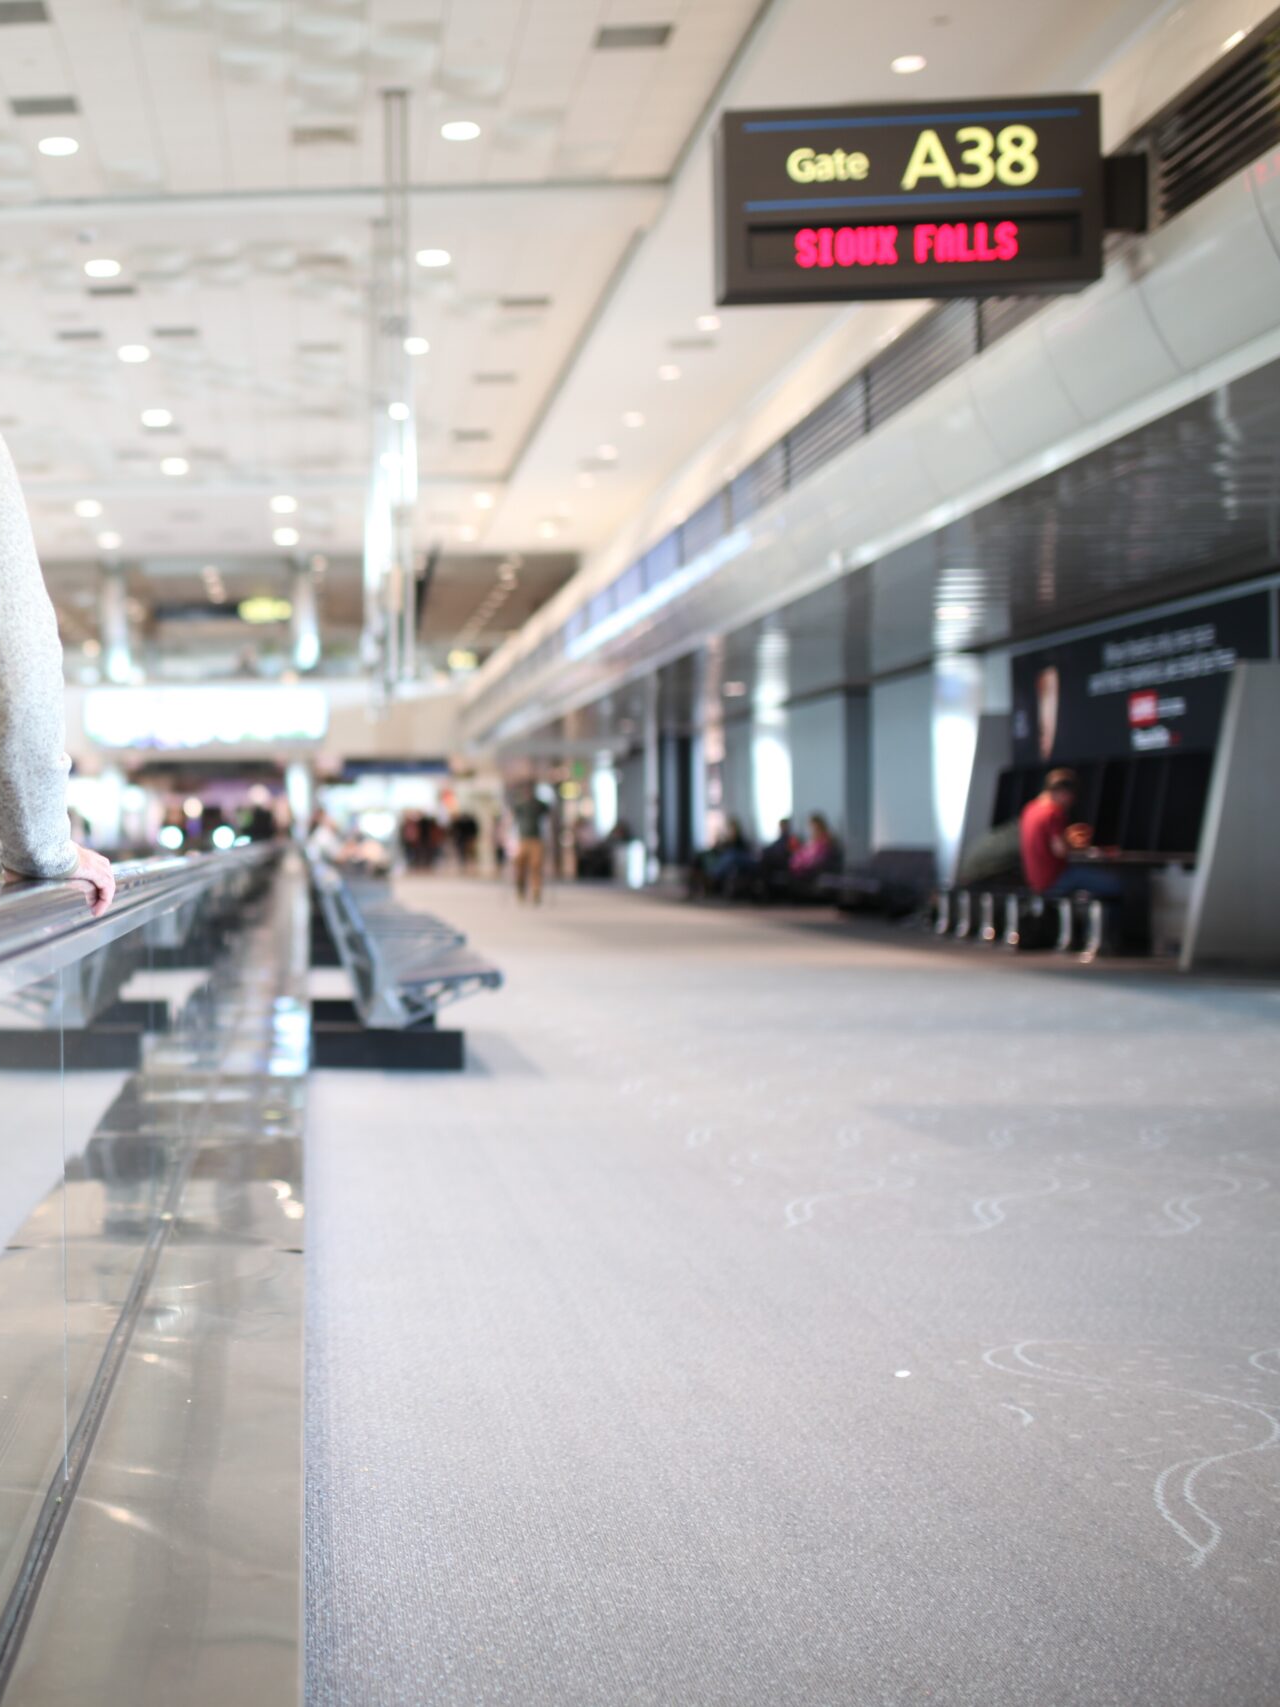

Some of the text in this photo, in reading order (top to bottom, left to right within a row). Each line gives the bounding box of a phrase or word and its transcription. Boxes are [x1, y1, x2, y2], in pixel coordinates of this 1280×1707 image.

[786, 124, 1039, 190] Gate A38
[794, 221, 1018, 268] SIOUX FALLS
